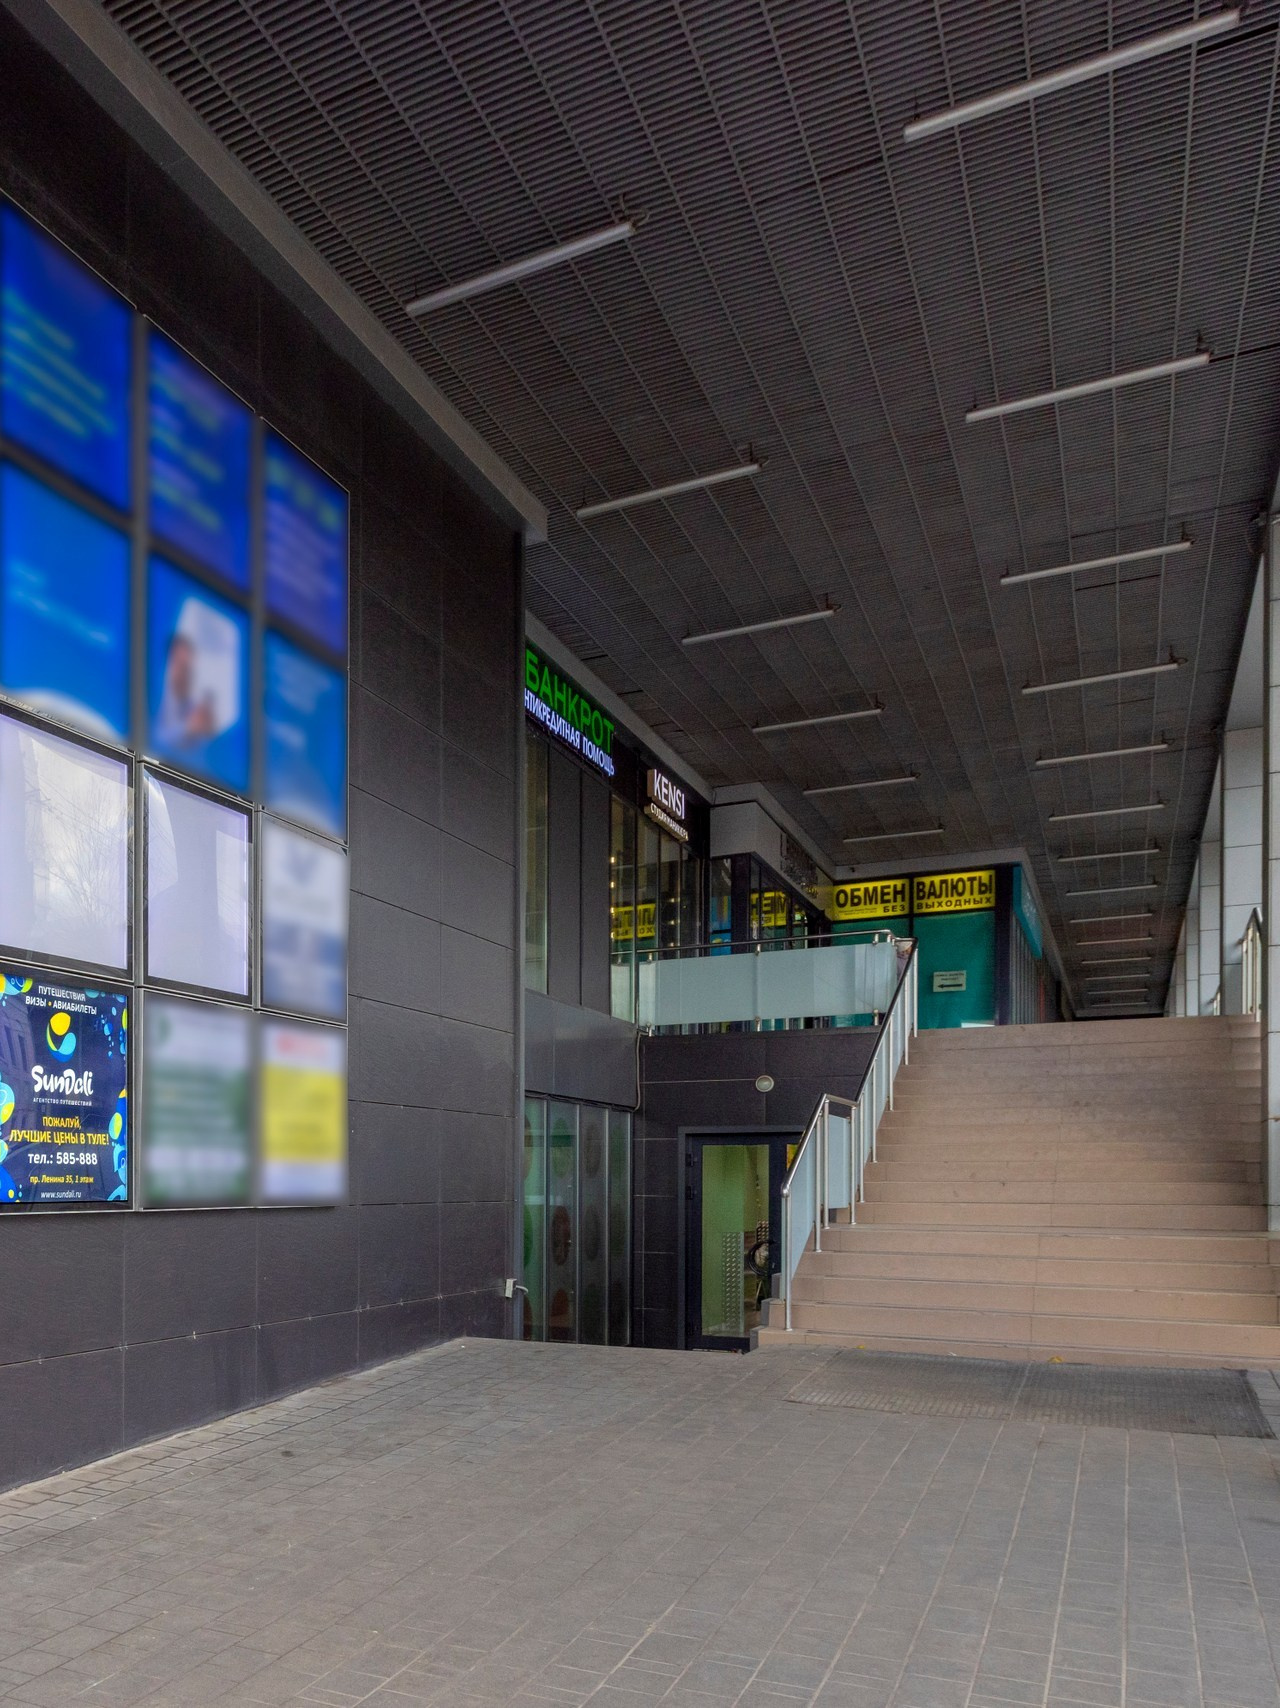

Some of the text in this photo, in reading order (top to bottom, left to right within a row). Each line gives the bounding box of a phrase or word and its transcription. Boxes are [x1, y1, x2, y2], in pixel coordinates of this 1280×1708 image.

[525, 650, 615, 754] БАНКРОТ
[524, 688, 615, 776] НТИКРЕДИТНАЯ ПОМОЩЬ
[653, 769, 685, 819] KENSI
[835, 874, 993, 908] ОБМЕН ВАЛЮТЫ
[883, 904, 906, 913] БЕЗ
[916, 897, 992, 910] ВЫХОДНЫХ
[38, 985, 86, 1002] ПУТЕШЕСТВИЯ
[25, 996, 97, 1015] ВИЗЫ АВИАБИЛЕТЫ
[31, 1065, 94, 1096] SunDali
[42, 1116, 82, 1130] ПОЖАЛУЙ,
[9, 1129, 109, 1146] ЛУЧШИЕ ЦЕНЫ В ТУЛЕ!
[28, 1152, 98, 1165] тел.: 585-888
[30, 1176, 40, 1185] пр.
[41, 1175, 64, 1183] Ленина
[65, 1175, 74, 1185] 35,
[40, 1191, 81, 1199] www.sundali.ru
